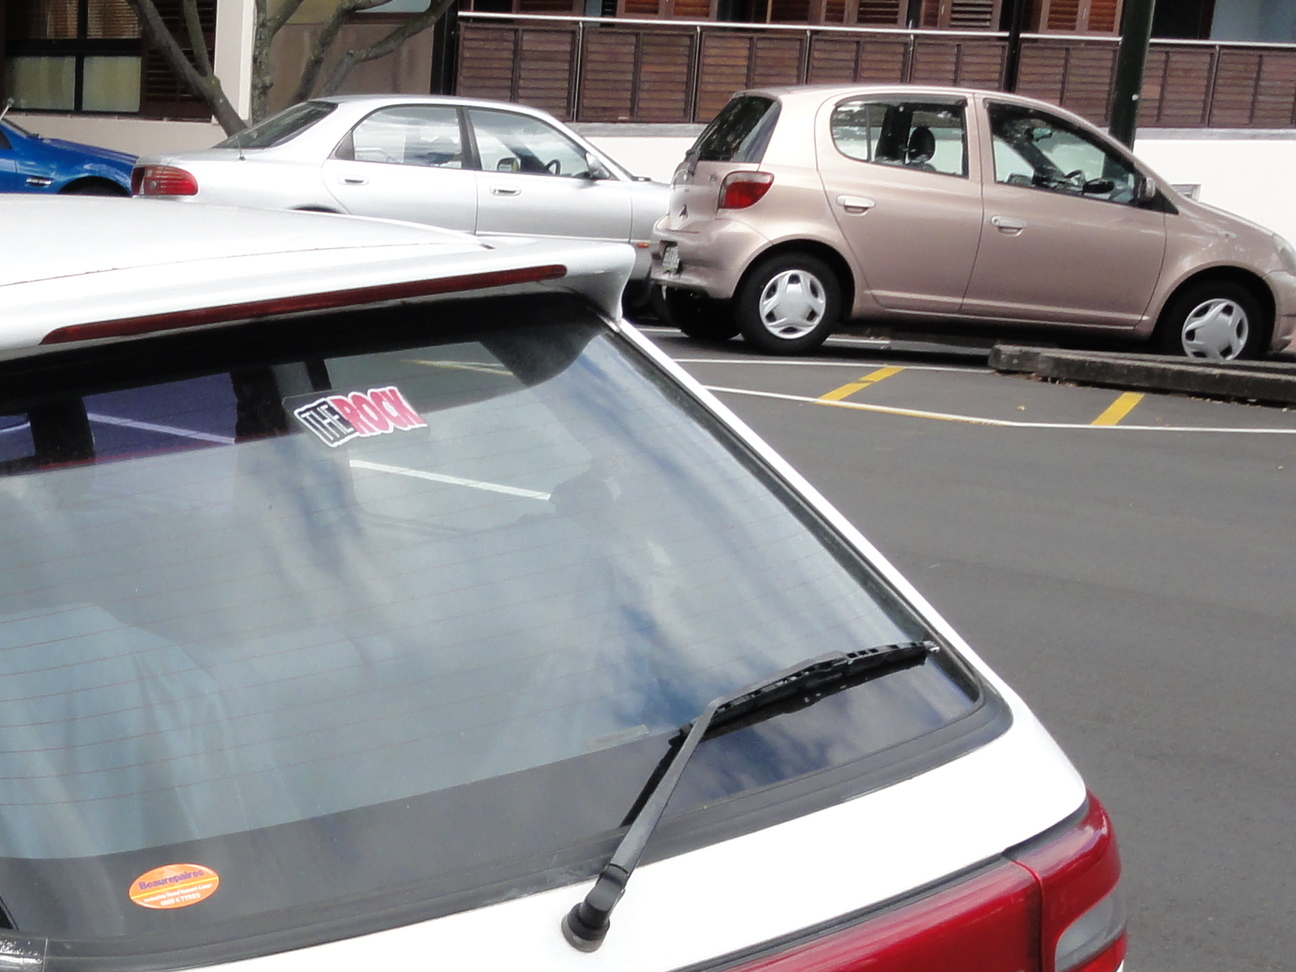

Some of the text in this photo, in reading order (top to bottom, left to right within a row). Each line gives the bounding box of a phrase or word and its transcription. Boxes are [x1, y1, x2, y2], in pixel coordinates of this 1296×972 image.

[301, 387, 427, 441] THE ROCK
[138, 870, 205, 890] Beaurepaires
